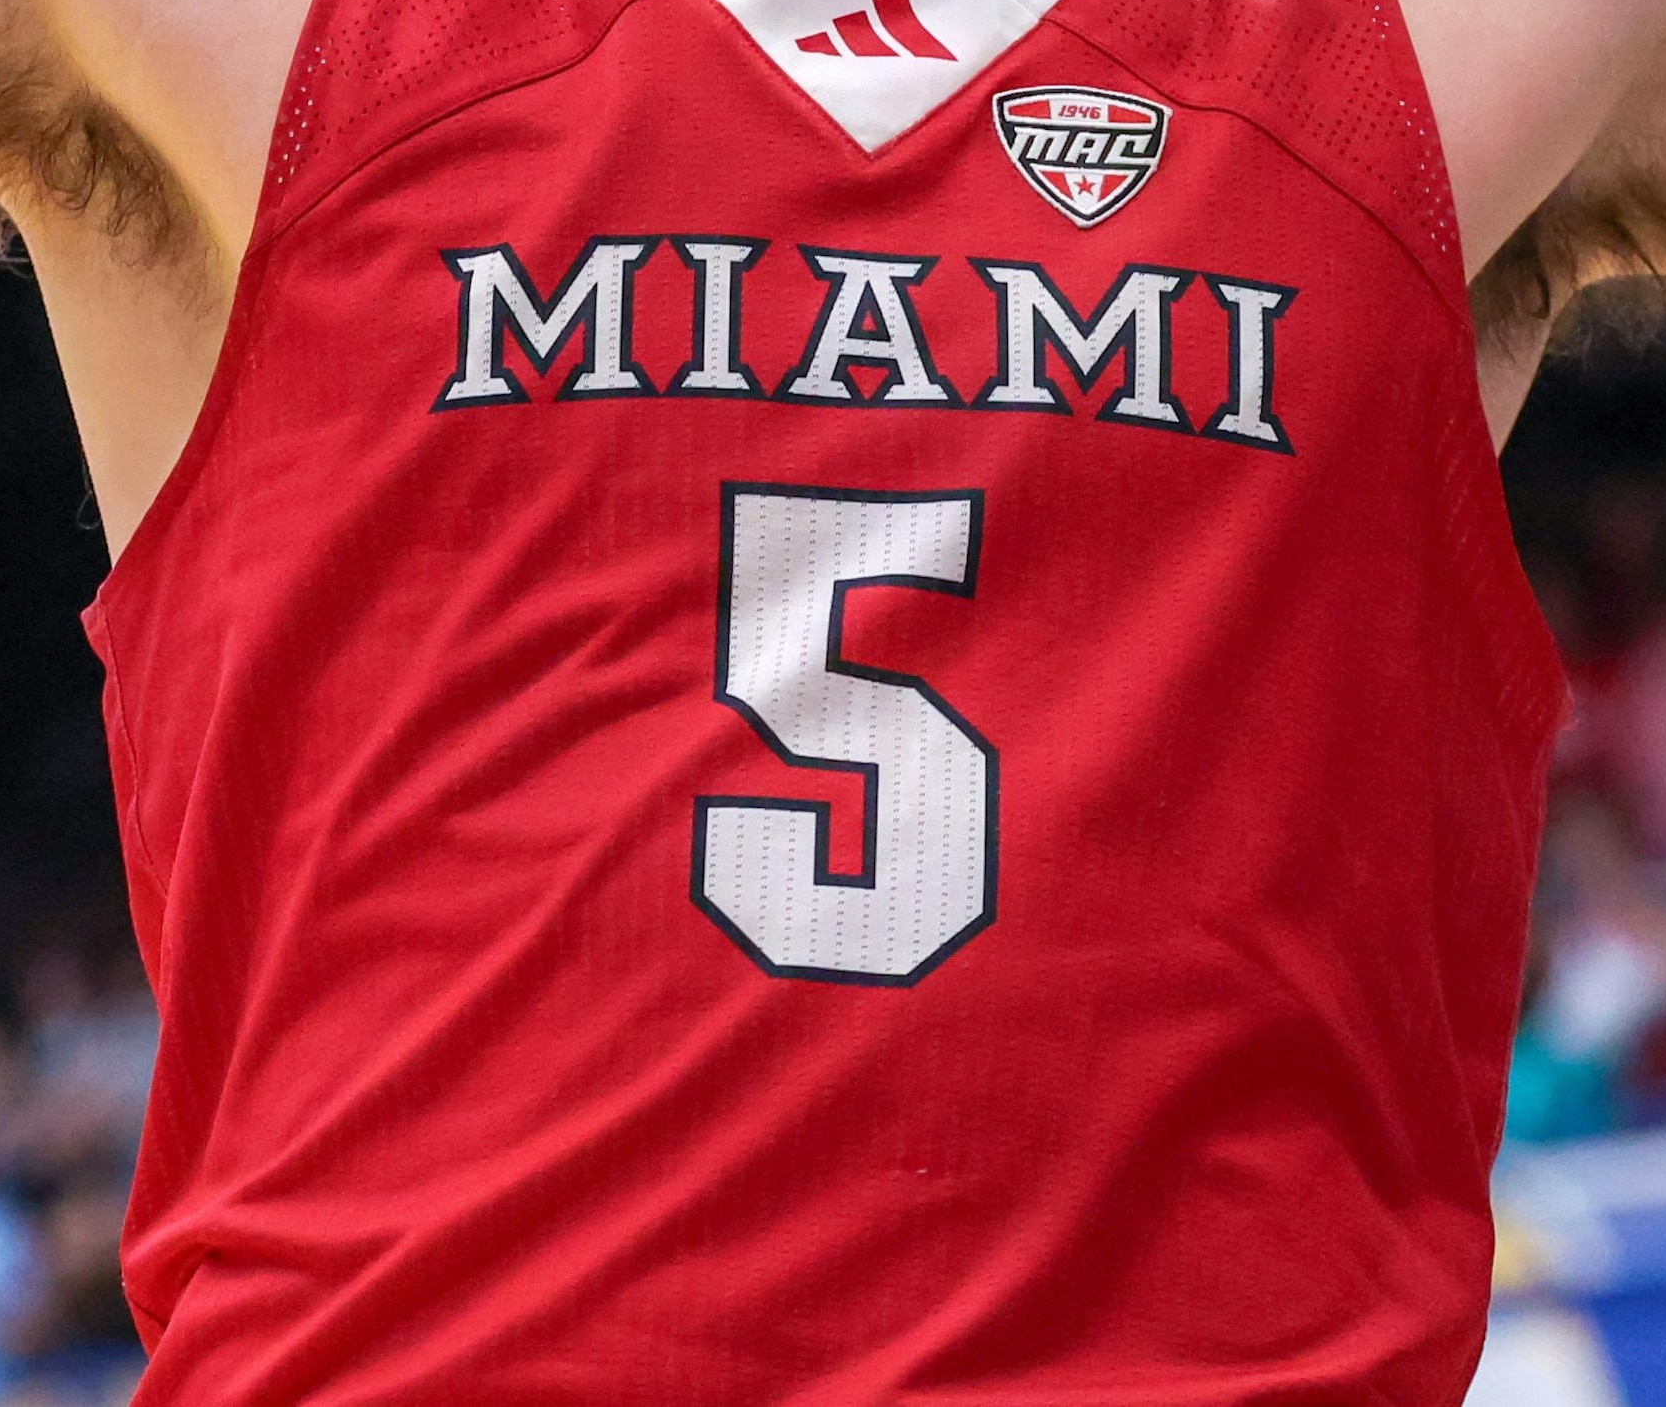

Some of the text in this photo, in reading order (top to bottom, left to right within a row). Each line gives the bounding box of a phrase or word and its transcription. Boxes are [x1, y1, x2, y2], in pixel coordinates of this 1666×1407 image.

[1010, 125, 1155, 165] MAC
[1058, 104, 1102, 120] 1946
[429, 233, 1299, 456] MIAMI
[689, 480, 998, 989] 5
